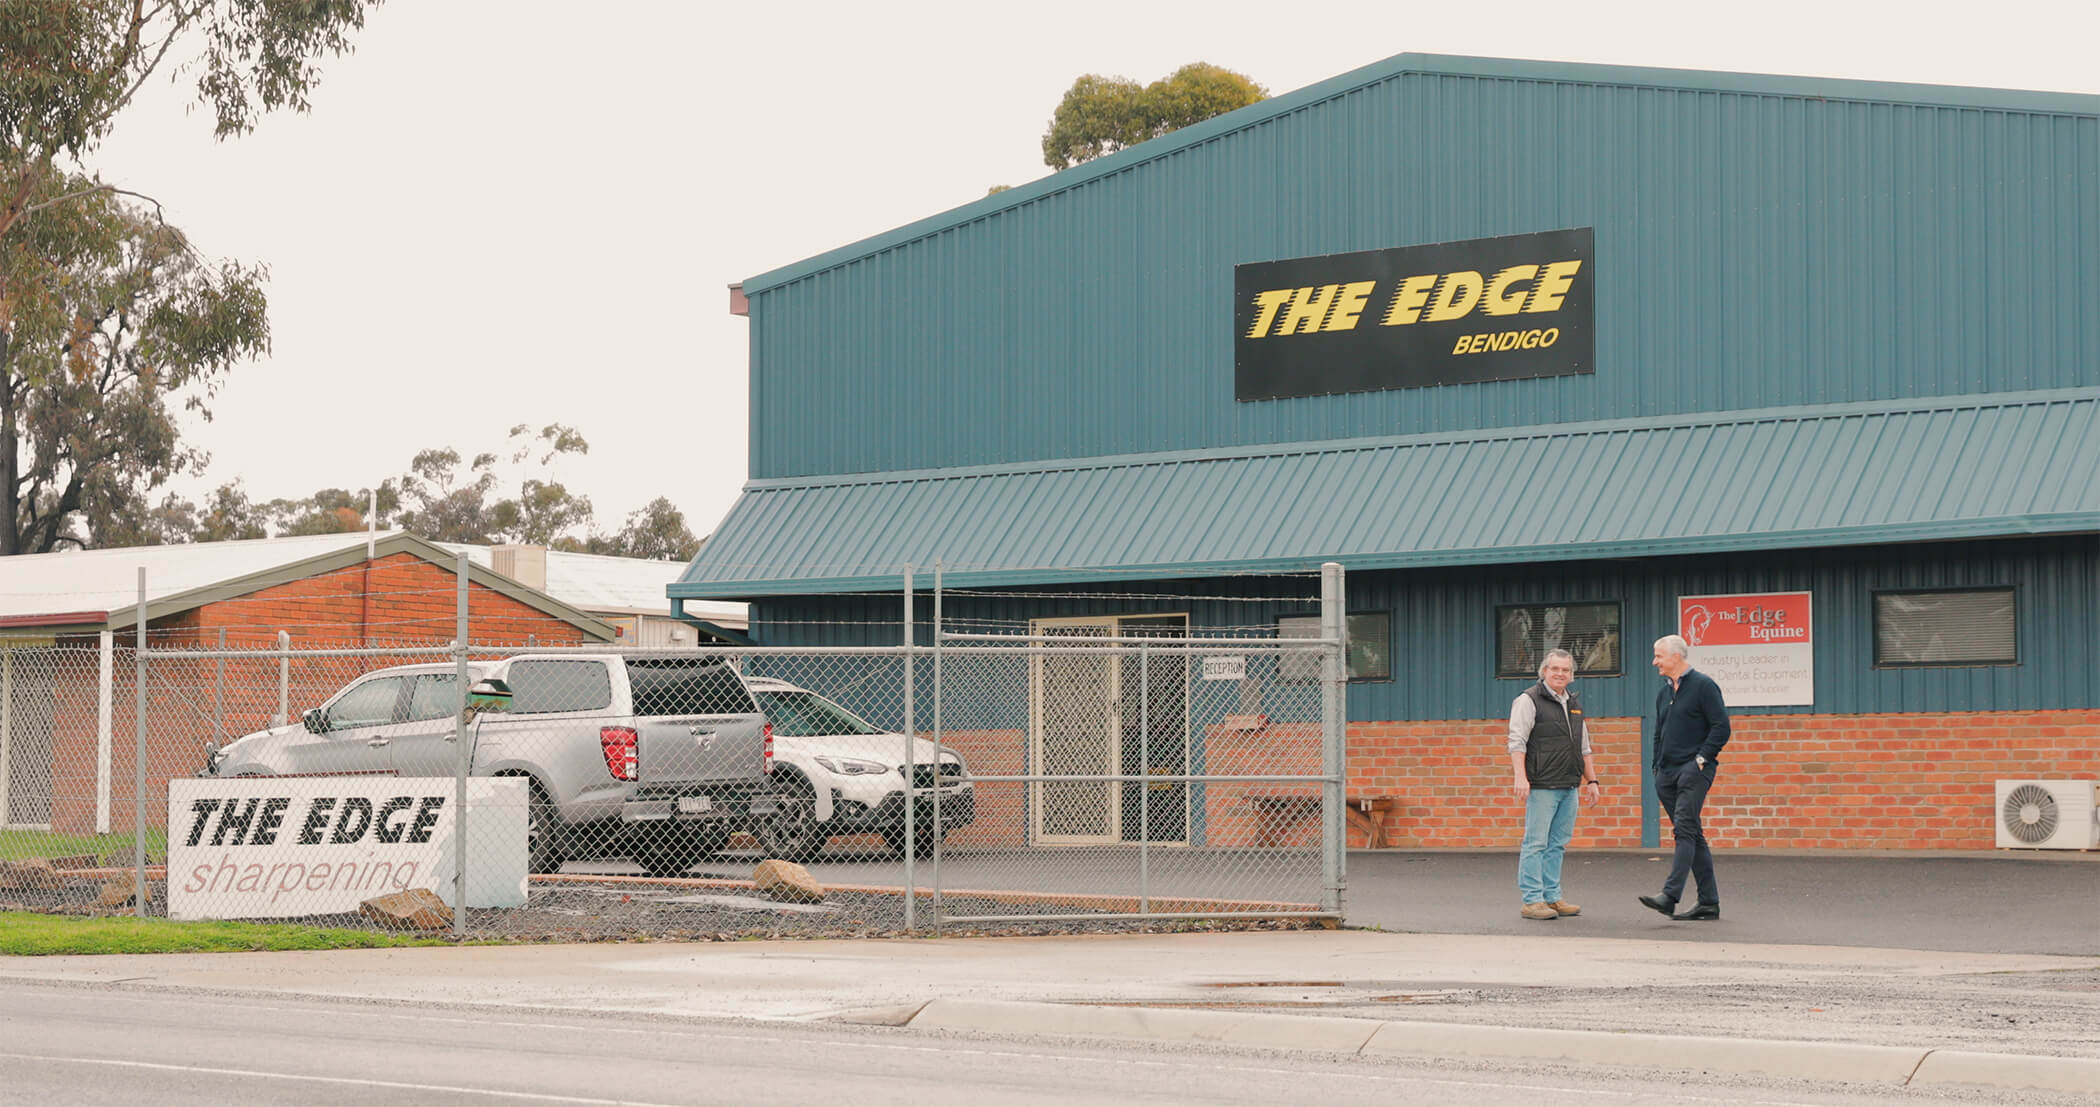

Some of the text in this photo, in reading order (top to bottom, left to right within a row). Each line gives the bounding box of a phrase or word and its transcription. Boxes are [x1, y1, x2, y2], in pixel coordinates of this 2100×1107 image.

[1245, 260, 1582, 338] THE EDGE
[1452, 328, 1560, 355] BENDIGO
[1718, 605, 1786, 627] The Edge
[1751, 624, 1804, 641] Equine
[1205, 662, 1243, 674] RECEPTION
[1701, 653, 1790, 667] Industry Leader in
[185, 796, 445, 846] THE EDGE
[184, 852, 419, 901] sharpening
